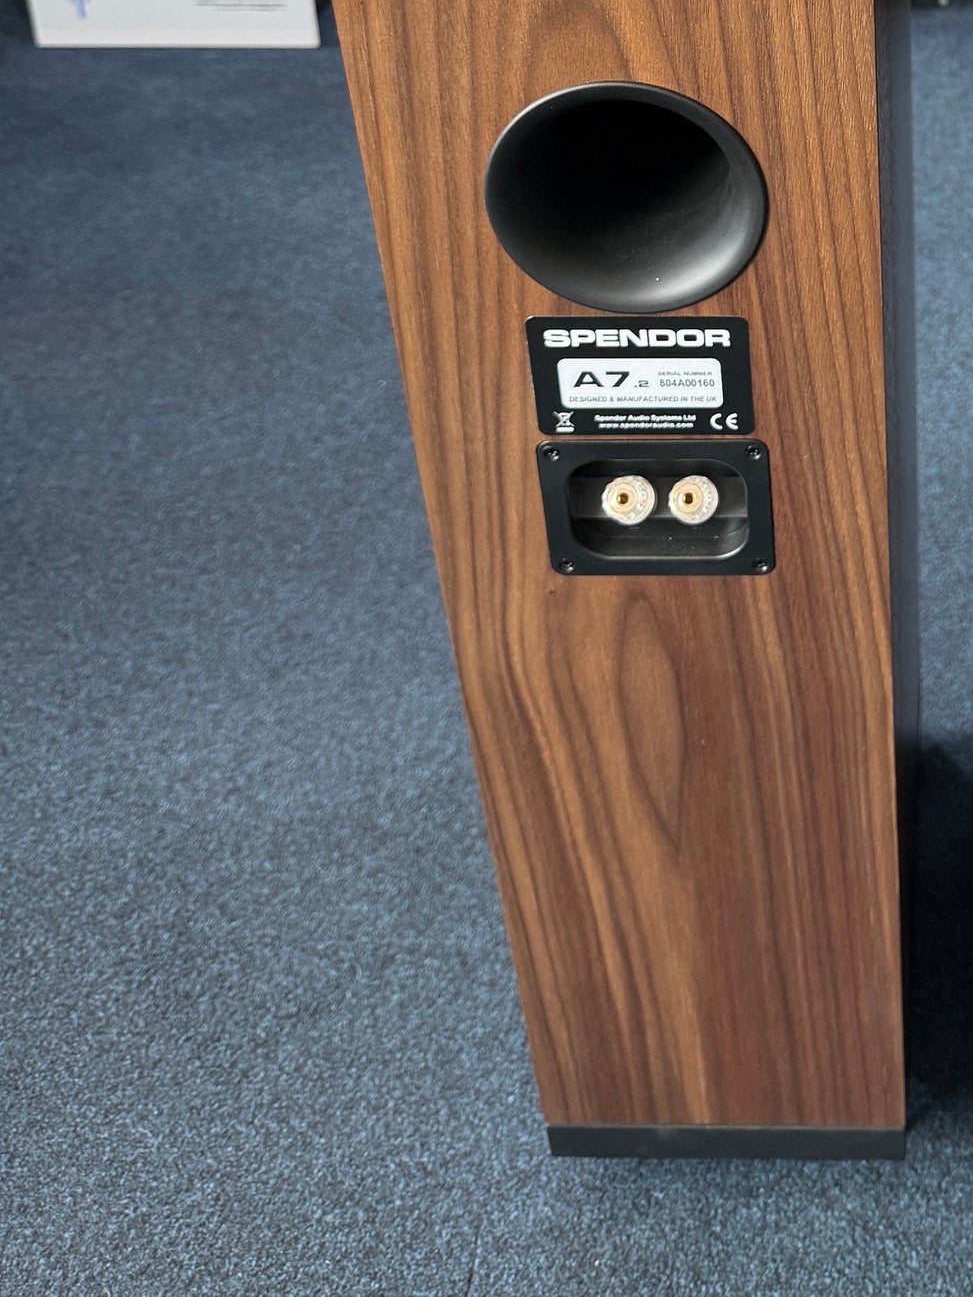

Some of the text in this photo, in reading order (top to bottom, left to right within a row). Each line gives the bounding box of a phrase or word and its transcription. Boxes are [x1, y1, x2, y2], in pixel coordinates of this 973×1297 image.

[543, 328, 731, 348] SPENDOR
[659, 378, 715, 388] 804A00160
[569, 395, 608, 403] DESIGNED
[616, 395, 679, 403] MANUFACTURED
[680, 395, 689, 403] IN
[690, 395, 704, 403] THE
[706, 395, 717, 403] UK
[594, 414, 696, 423] Spendor Audio Systems Ltd
[598, 422, 694, 430] www.spendoraudio.com
